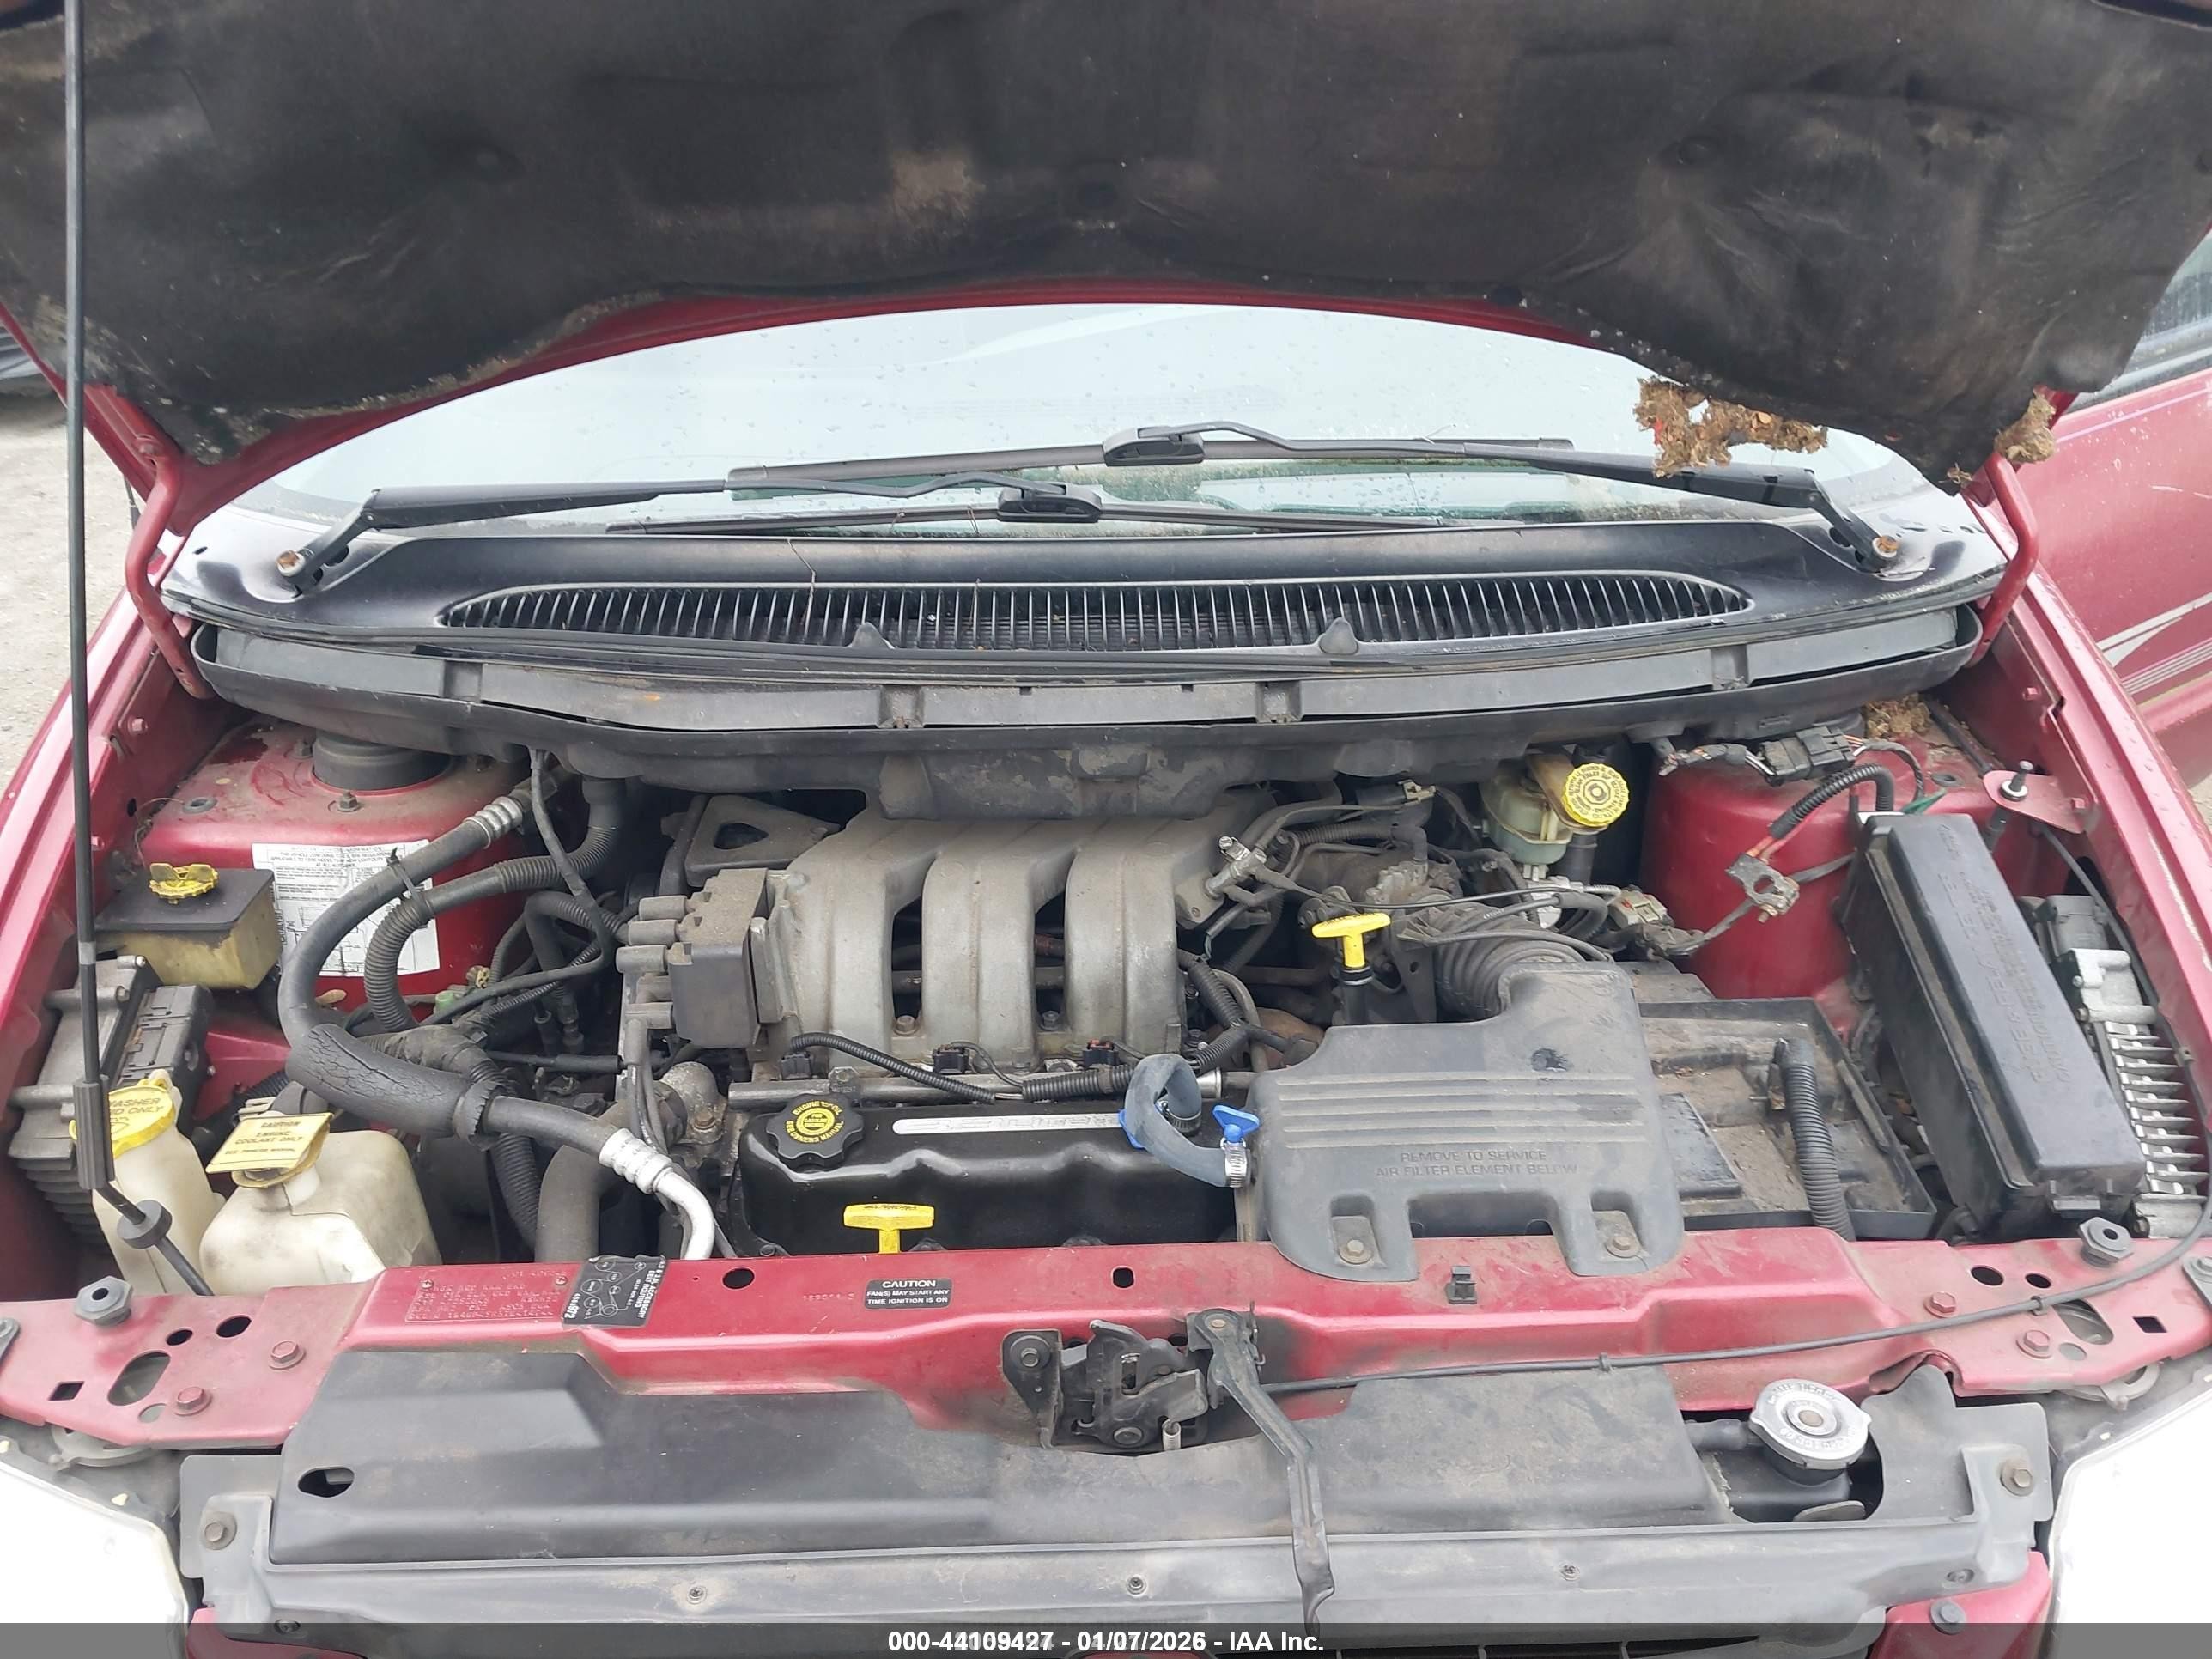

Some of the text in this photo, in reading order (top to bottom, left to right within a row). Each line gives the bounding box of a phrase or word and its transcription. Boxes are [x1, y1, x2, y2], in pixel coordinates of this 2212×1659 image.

[792, 1101, 842, 1115] ENGINE OIL
[790, 1131, 820, 1143] OWNERS
[820, 1121, 844, 1140] MANUAL
[1401, 1150, 1547, 1162] REMOVE TO SERVICE
[1376, 1164, 1577, 1176] AIR FILTER ELEMENT BELOW
[635, 1270, 655, 1308] BELT ROUTING
[637, 1286, 656, 1319] ACCESSORY
